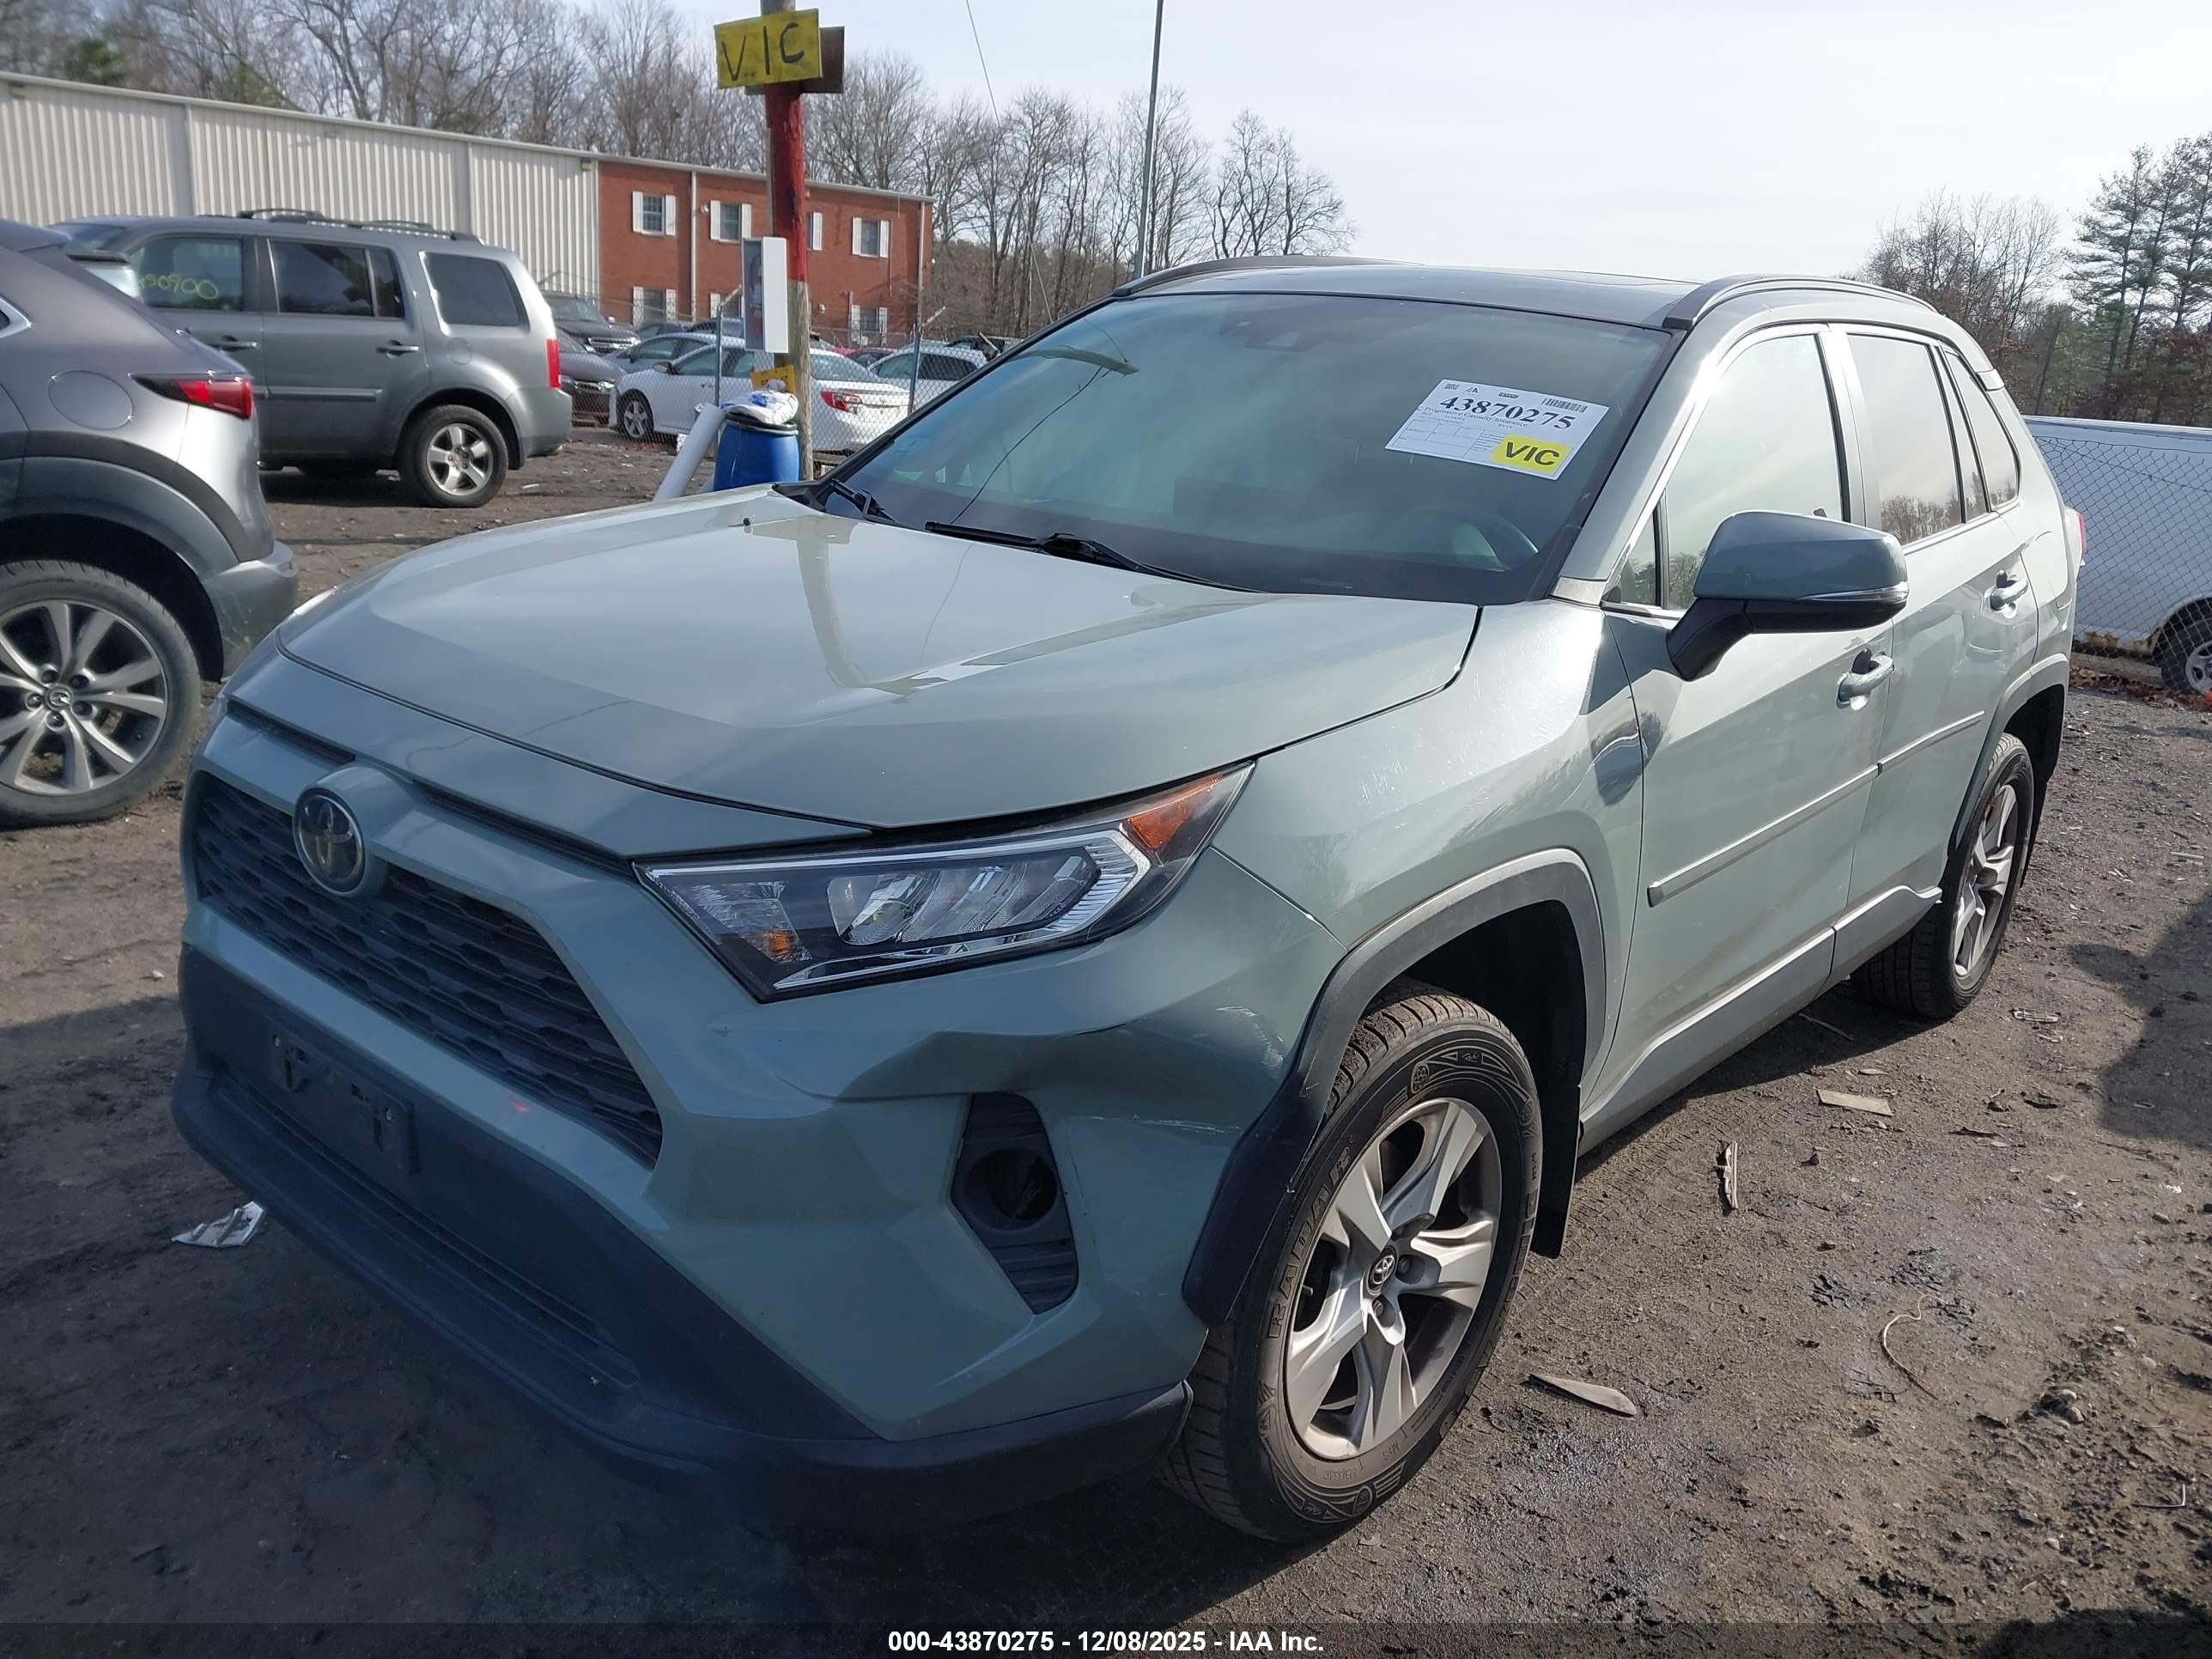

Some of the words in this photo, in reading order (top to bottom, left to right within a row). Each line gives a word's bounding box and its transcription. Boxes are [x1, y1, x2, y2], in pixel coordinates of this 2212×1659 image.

[721, 22, 805, 82] VIC
[1439, 395, 1577, 430] 43870275
[1504, 441, 1560, 466] VIC
